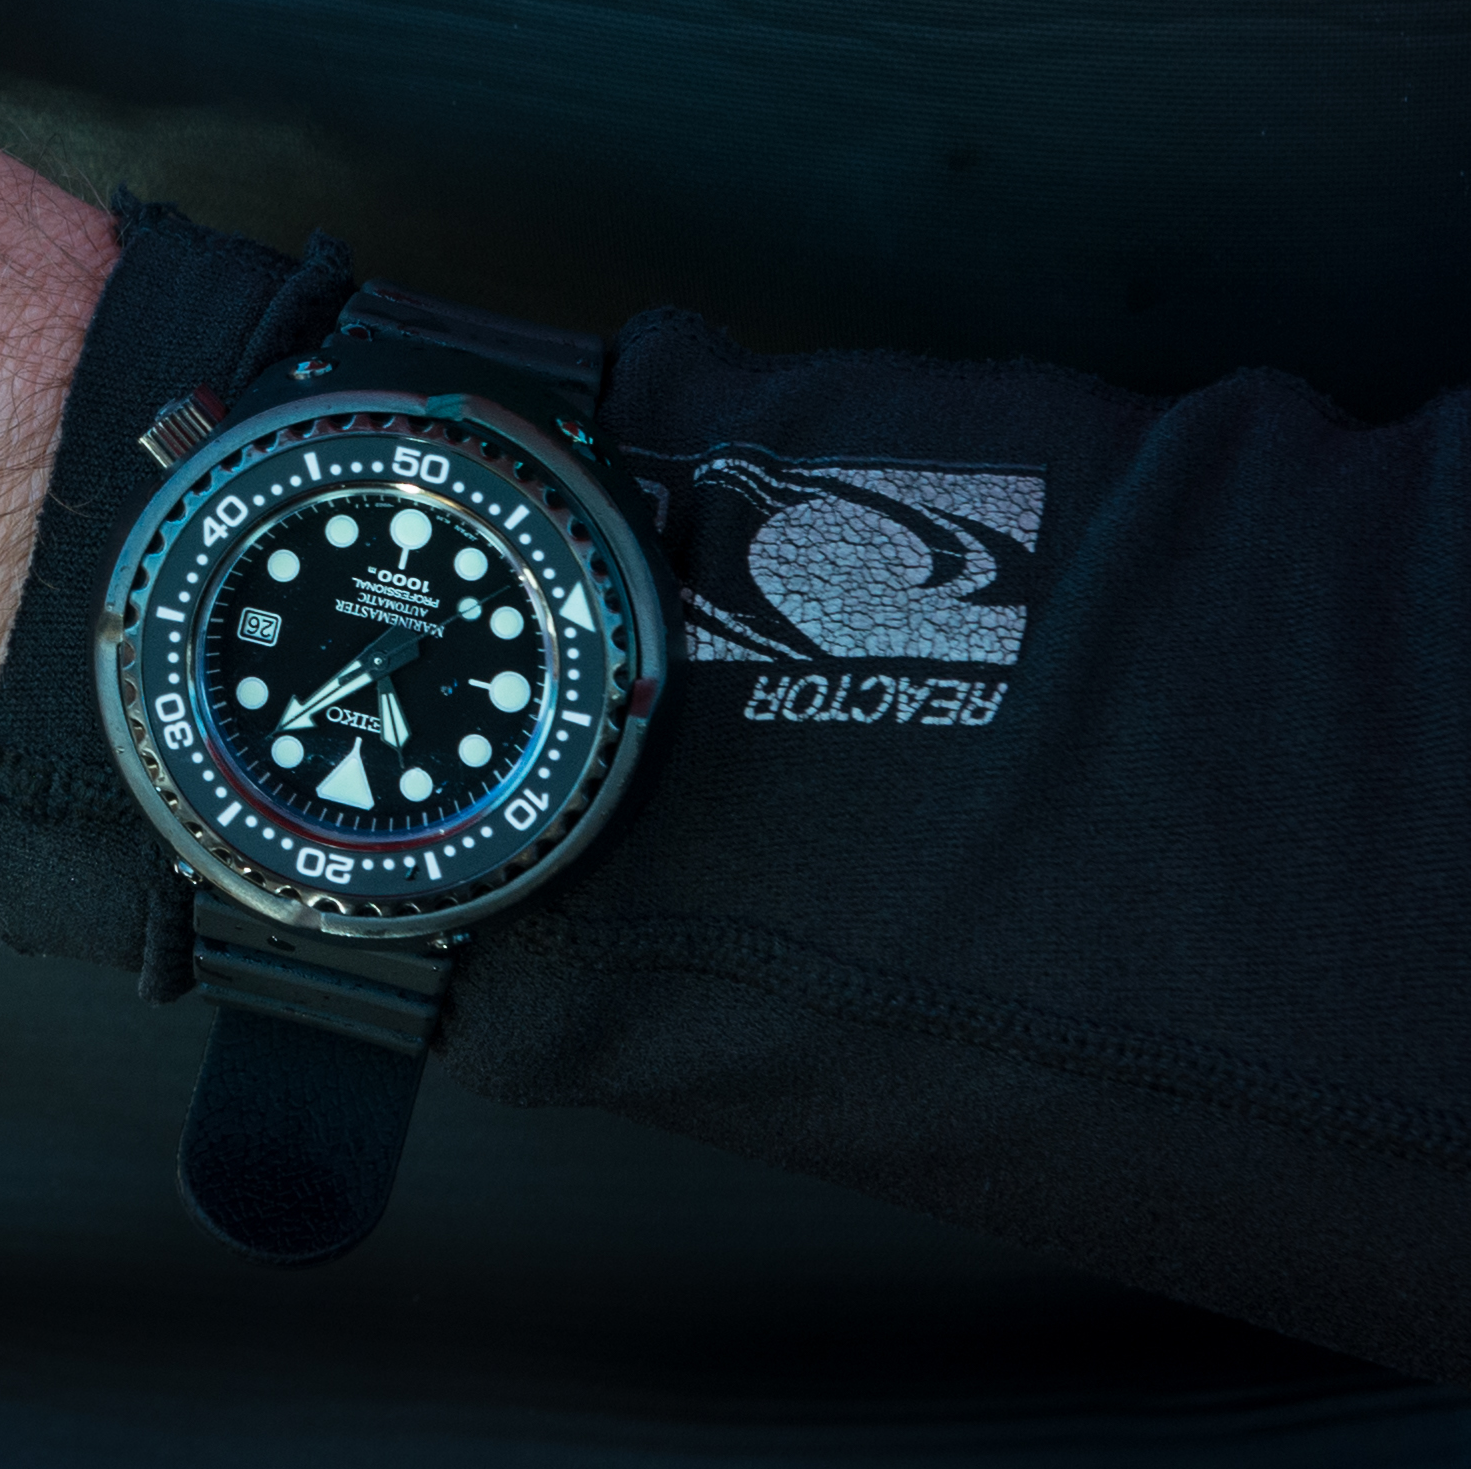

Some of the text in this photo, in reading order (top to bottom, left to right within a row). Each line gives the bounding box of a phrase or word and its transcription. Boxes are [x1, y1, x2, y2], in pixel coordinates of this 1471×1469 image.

[391, 447, 450, 485] 50
[201, 495, 247, 539] 40
[351, 576, 440, 609] PROFESSIONAL
[357, 591, 429, 618] AUTOMATIC
[246, 614, 273, 640] 26
[334, 598, 446, 639] MARINEMASTER
[743, 673, 1009, 726] REACTOR
[155, 692, 195, 749] 30
[326, 706, 381, 734] EIKO
[502, 787, 551, 832] 10
[296, 846, 355, 885] 20
